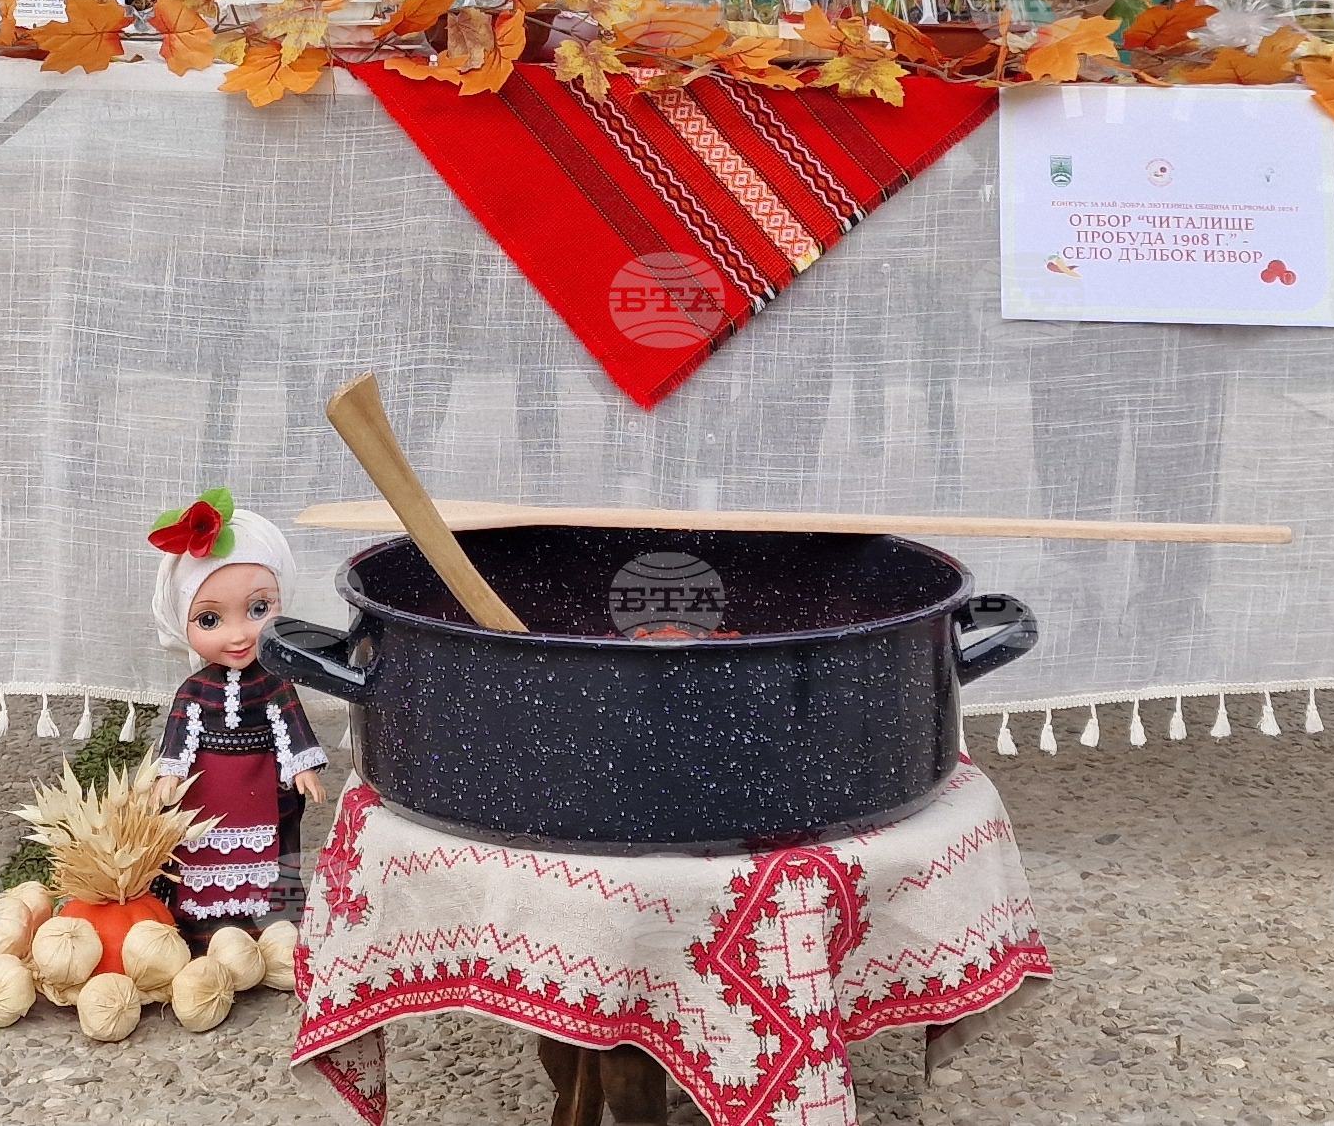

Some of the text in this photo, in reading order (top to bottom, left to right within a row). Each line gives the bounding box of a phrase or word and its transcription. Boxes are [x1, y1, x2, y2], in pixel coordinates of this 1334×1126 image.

[1069, 213, 1255, 232] ОТБОР “ЧИТАЛИЩЕ
[1076, 231, 1165, 246] ПРОБУДА
[1172, 233, 1210, 246] 1908
[1062, 247, 1264, 265] СЕЛО ДЪЛБОК ИЗВОР
